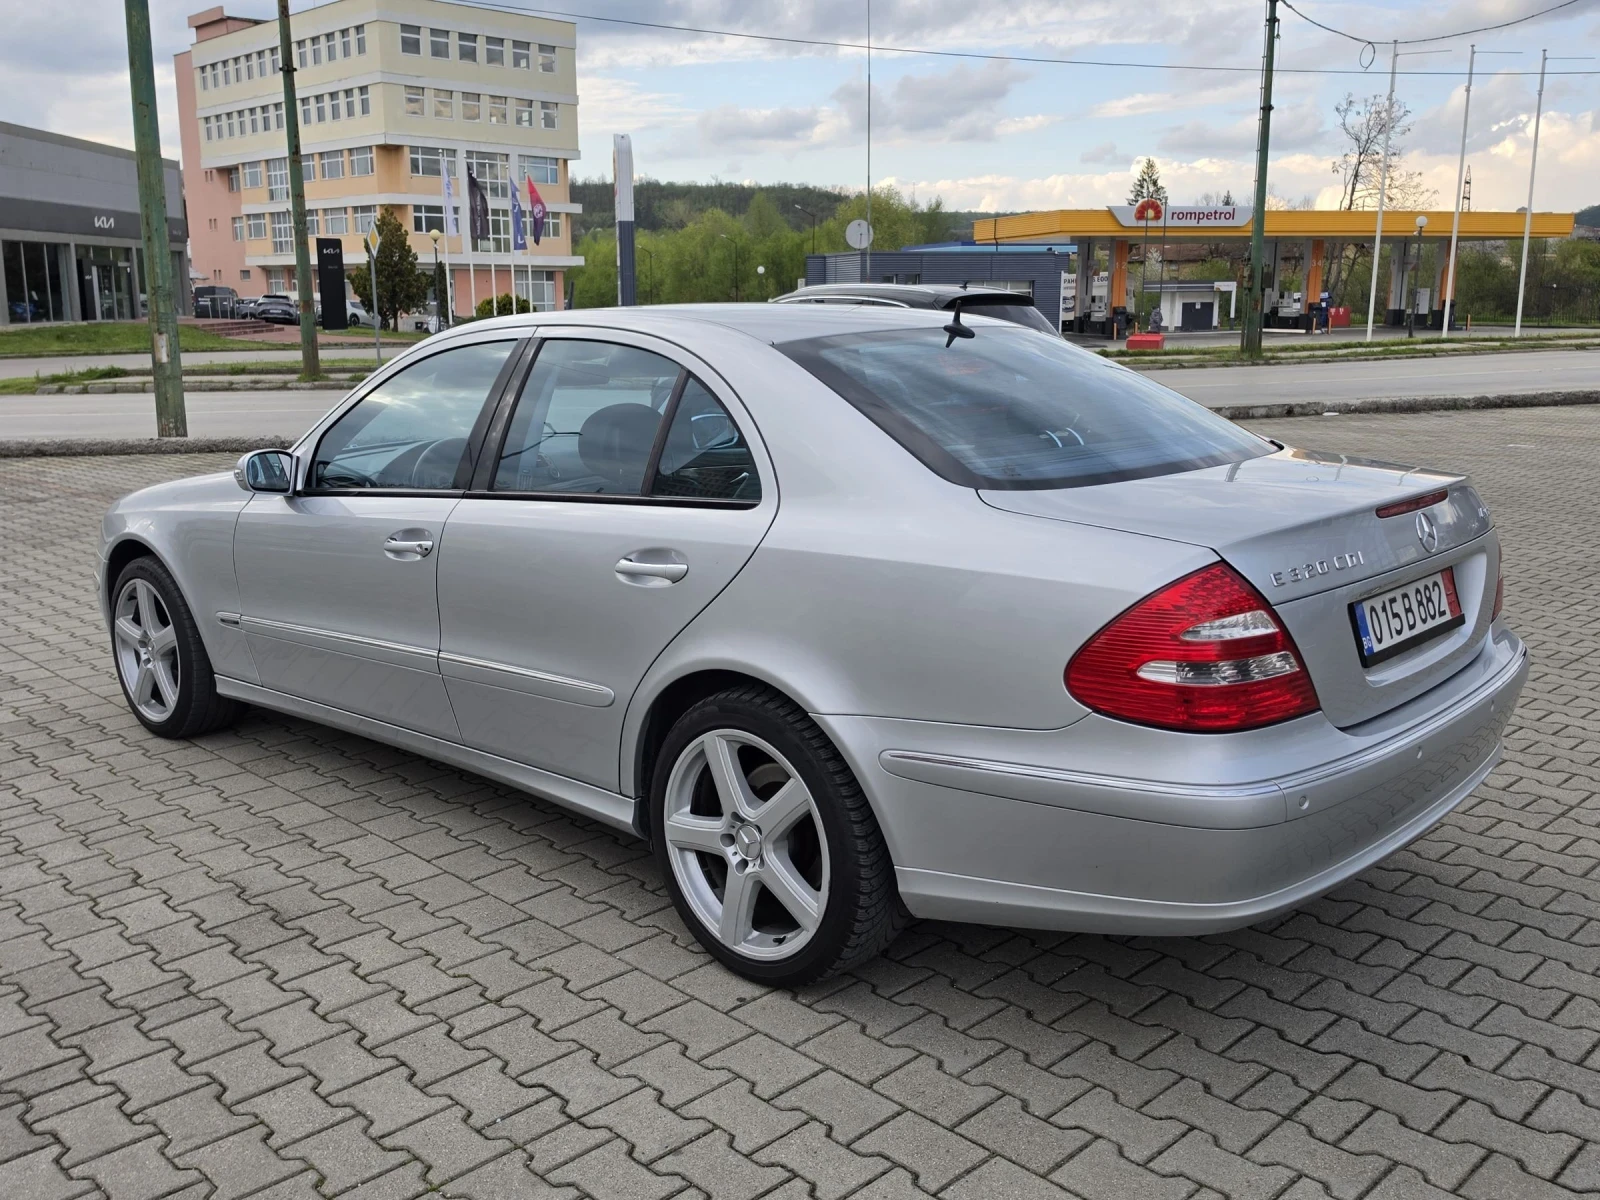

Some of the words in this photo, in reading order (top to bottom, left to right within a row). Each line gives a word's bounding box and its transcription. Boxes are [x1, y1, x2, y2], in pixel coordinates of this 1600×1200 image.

[94, 216, 114, 229] KIA
[1171, 208, 1236, 224] rompetrol
[1269, 571, 1286, 588] E
[1288, 559, 1330, 583] 320
[1333, 550, 1364, 571] CDI
[1362, 636, 1372, 650] BG
